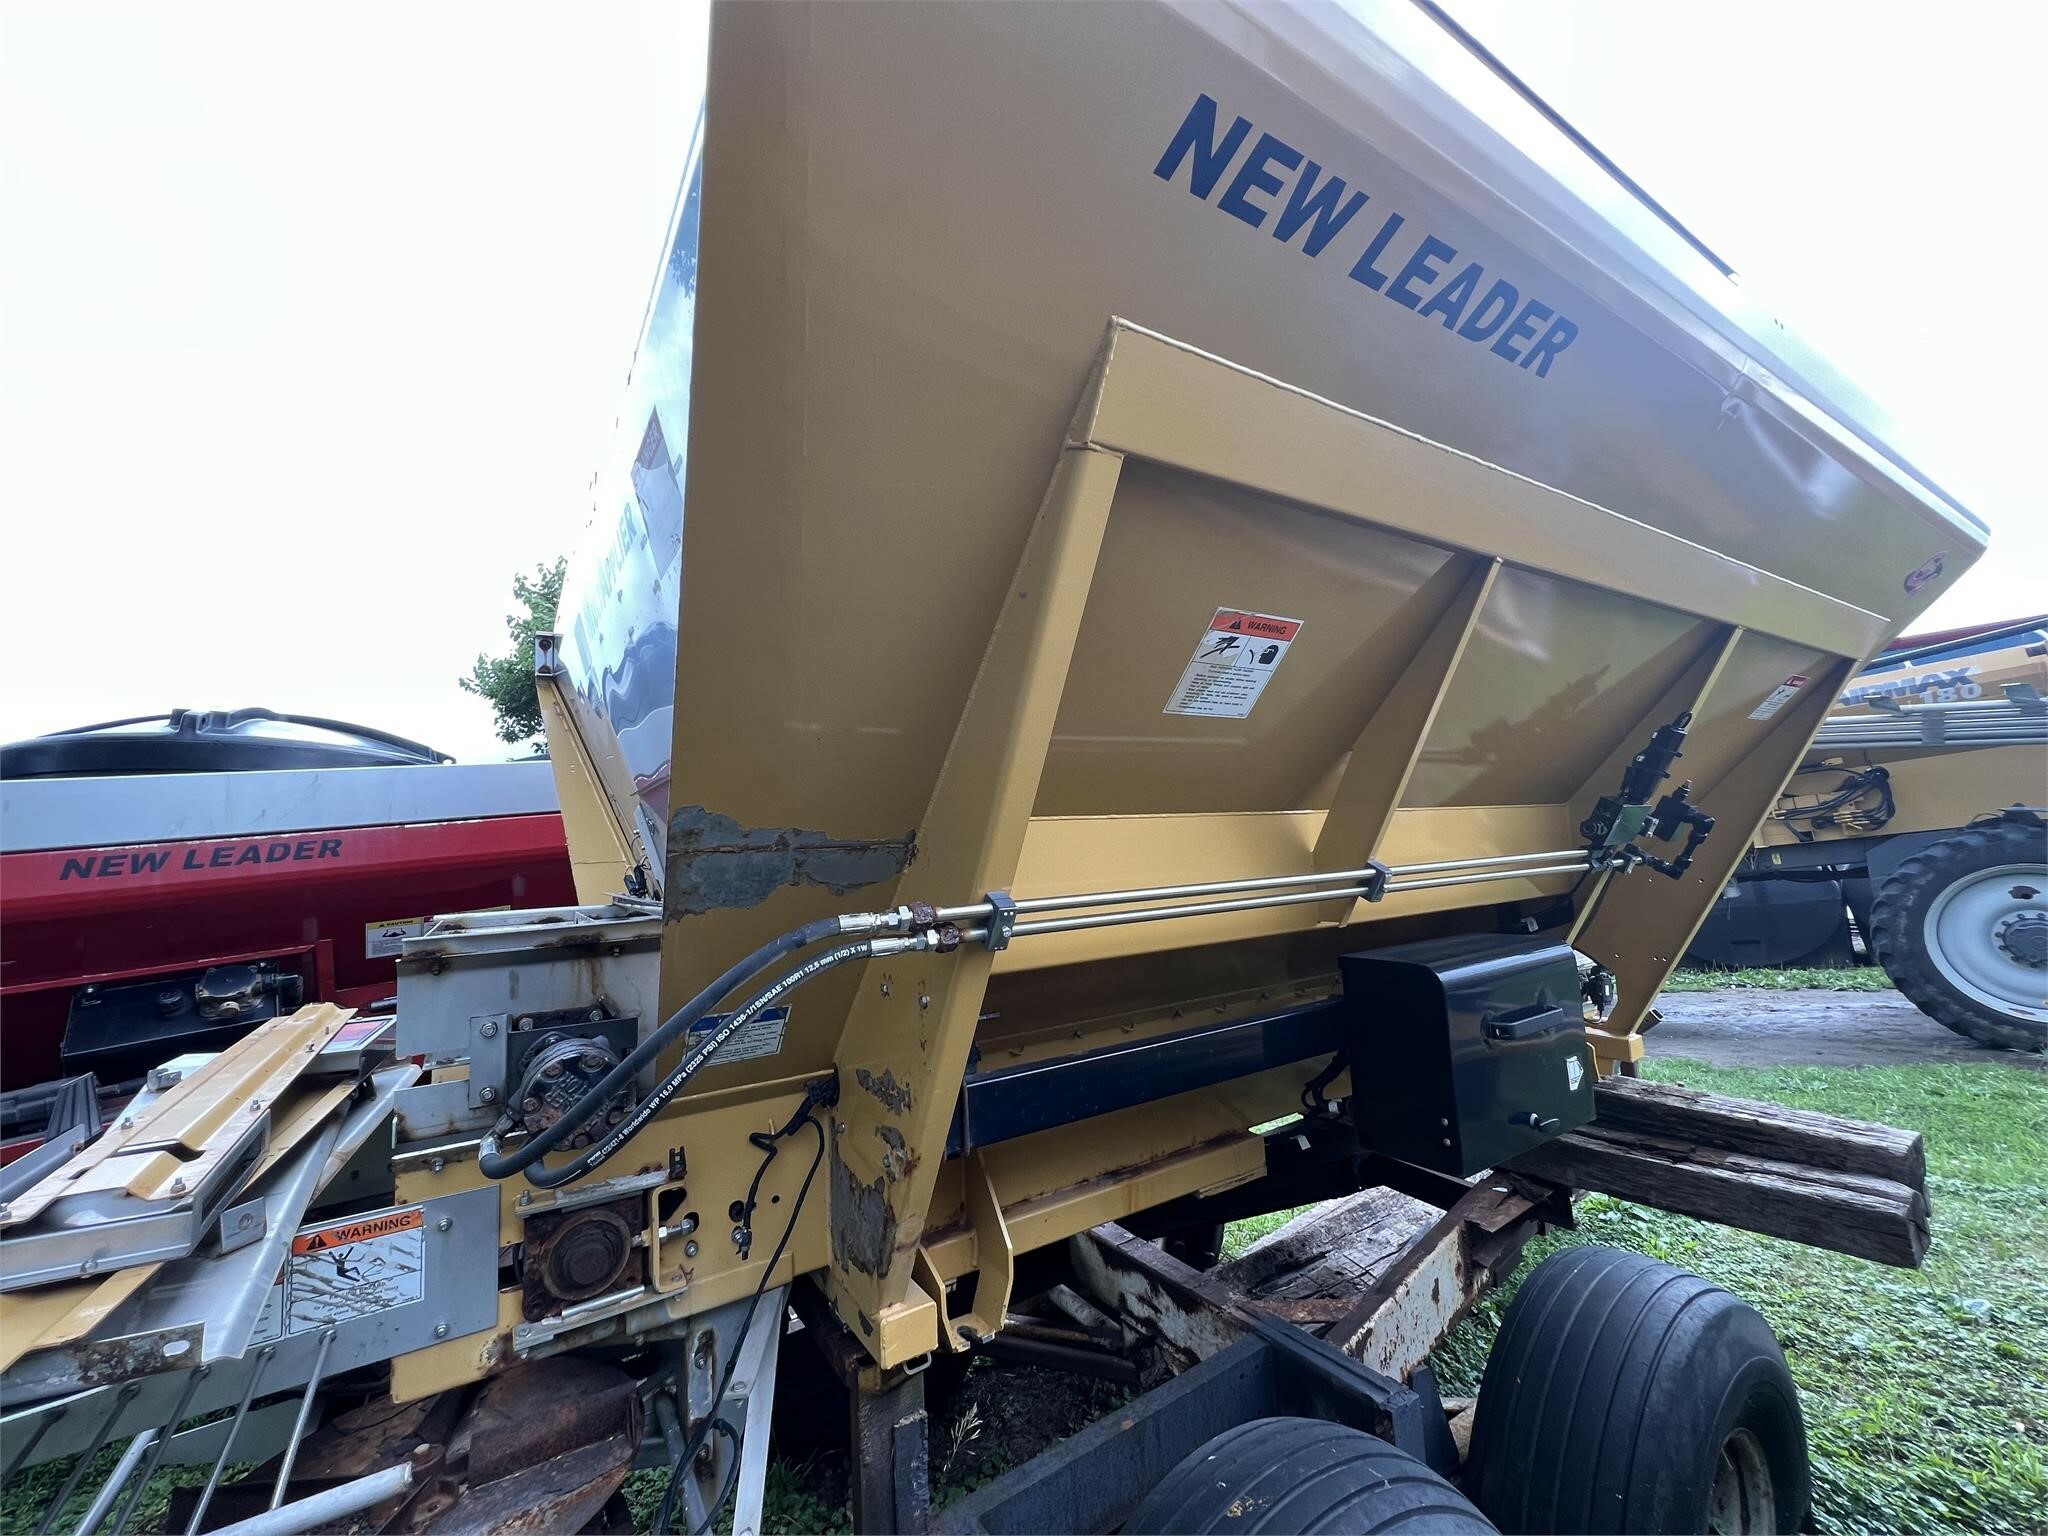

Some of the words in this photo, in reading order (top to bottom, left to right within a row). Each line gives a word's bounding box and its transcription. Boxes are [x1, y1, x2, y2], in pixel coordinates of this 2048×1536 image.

[1153, 93, 1370, 258] NEW
[1348, 212, 1579, 379] LEADER
[1247, 621, 1287, 635] WARNING
[1920, 683, 1982, 704] 180
[59, 850, 172, 881] NEW
[182, 838, 343, 870] LEADER
[622, 1108, 651, 1135] Worldwide
[648, 1097, 660, 1110] WP
[660, 1085, 674, 1099] 16,0
[671, 1071, 687, 1087] MPa
[685, 1053, 704, 1073] (2325
[702, 1040, 719, 1056] PSI)
[715, 1028, 730, 1043] ISO
[782, 970, 804, 987] 100R1
[820, 955, 834, 966] mm
[834, 948, 850, 960] (1/2)
[856, 944, 868, 952] 1W
[335, 1215, 411, 1242] WARNING
